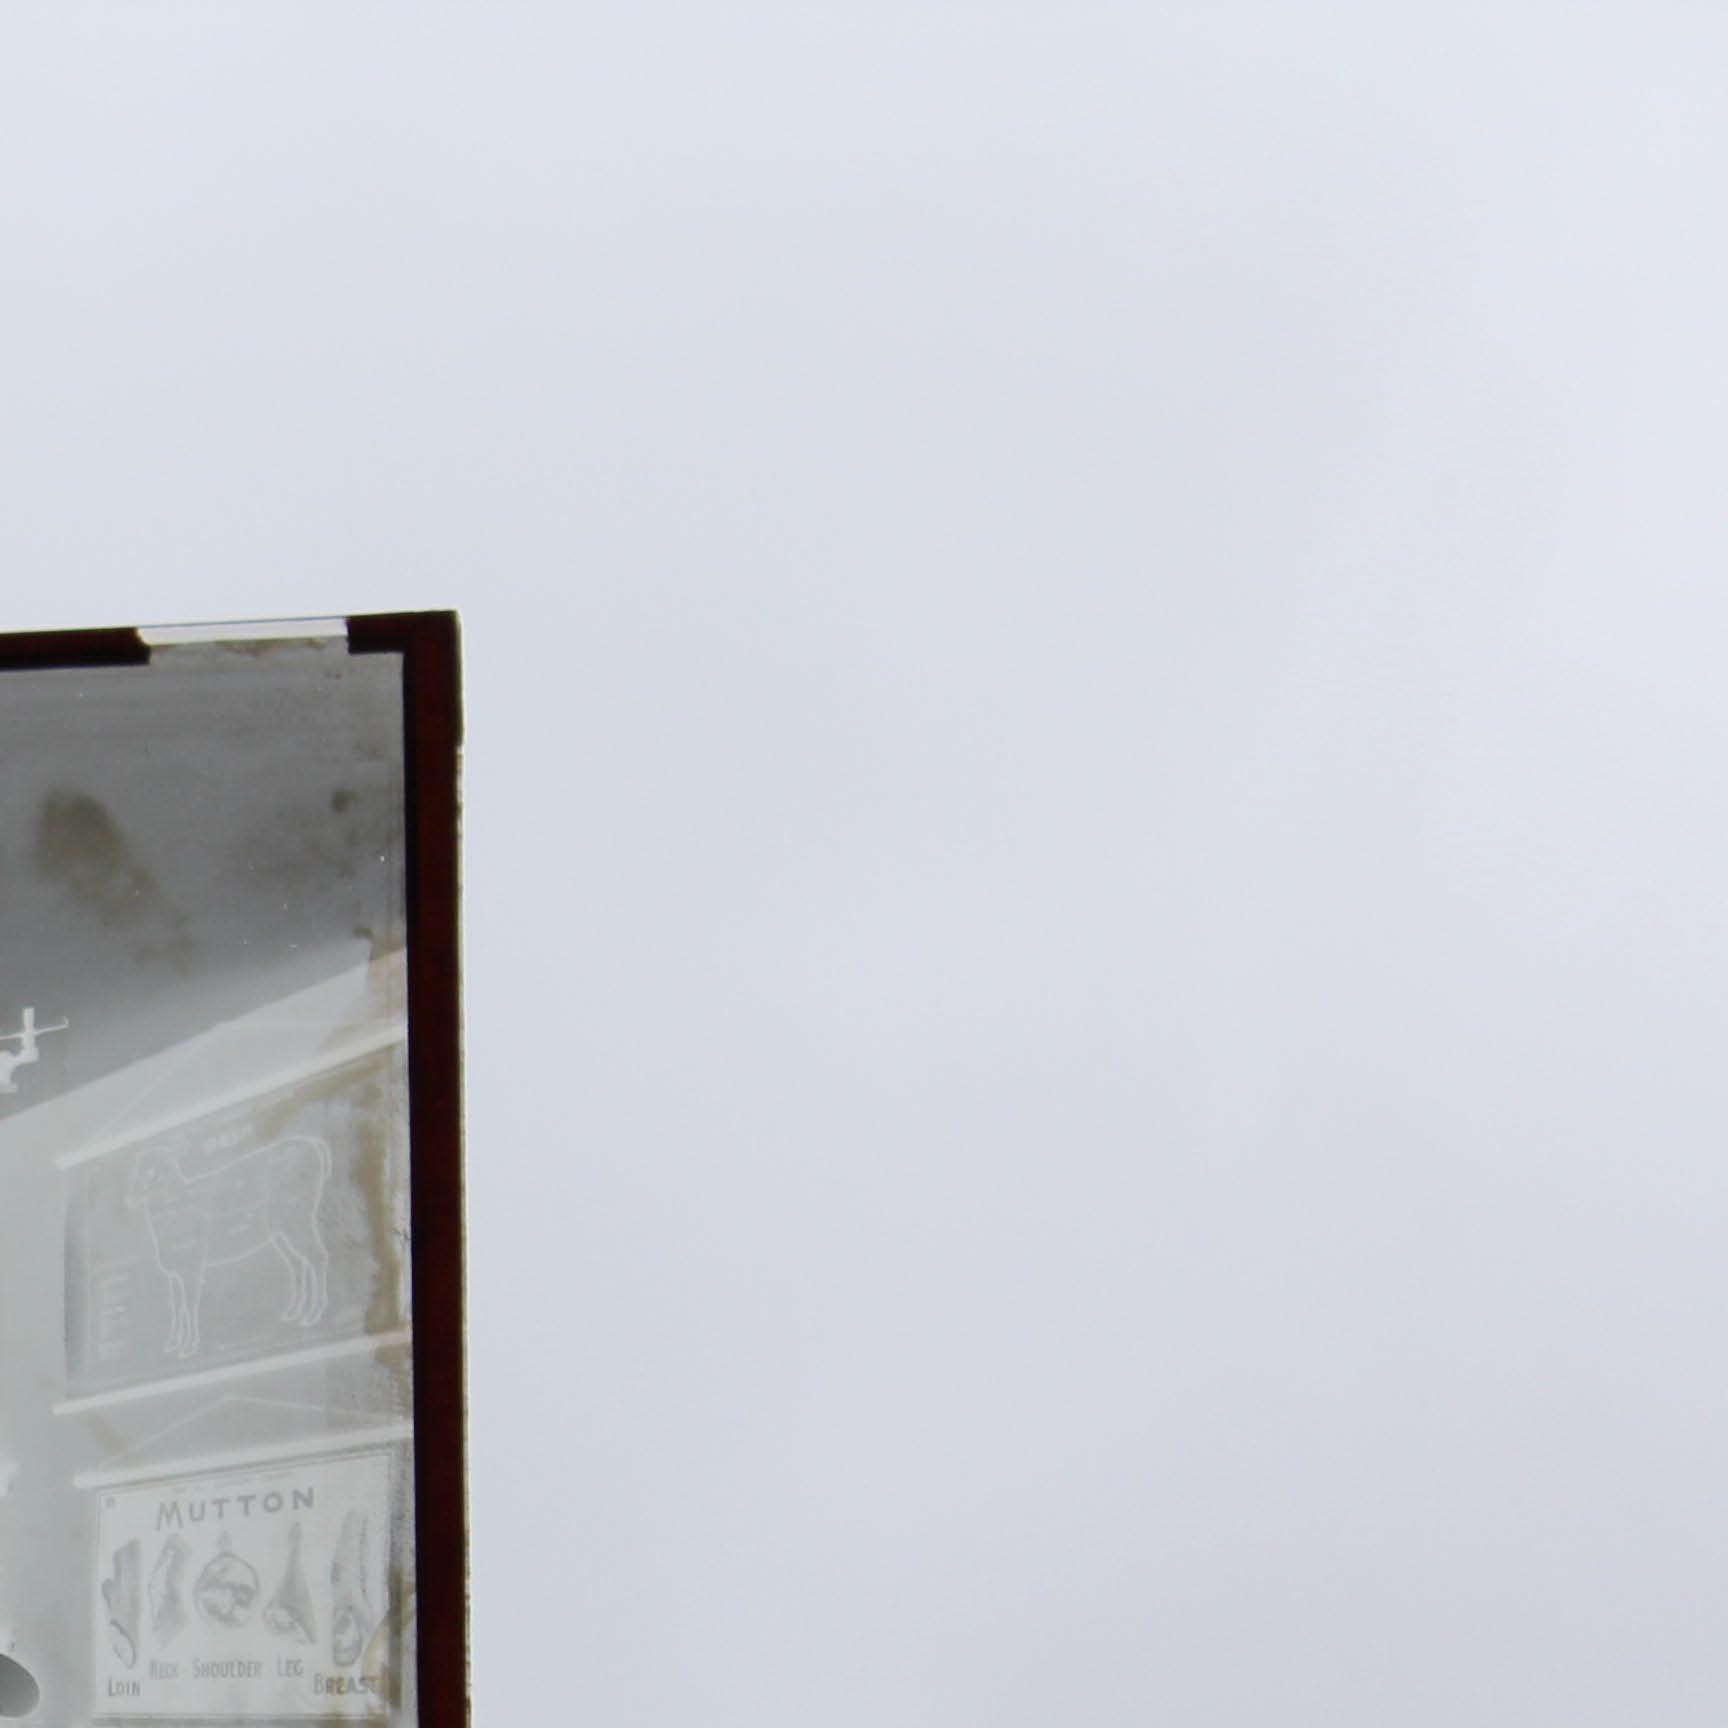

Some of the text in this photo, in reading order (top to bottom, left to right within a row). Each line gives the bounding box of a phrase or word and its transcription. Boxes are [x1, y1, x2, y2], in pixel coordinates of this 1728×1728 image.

[155, 1486, 314, 1531] MUTTON
[107, 1674, 141, 1698] LOIN
[192, 1656, 263, 1680] SHOULDER
[276, 1655, 304, 1678] LEG
[313, 1672, 378, 1697] BREAST
